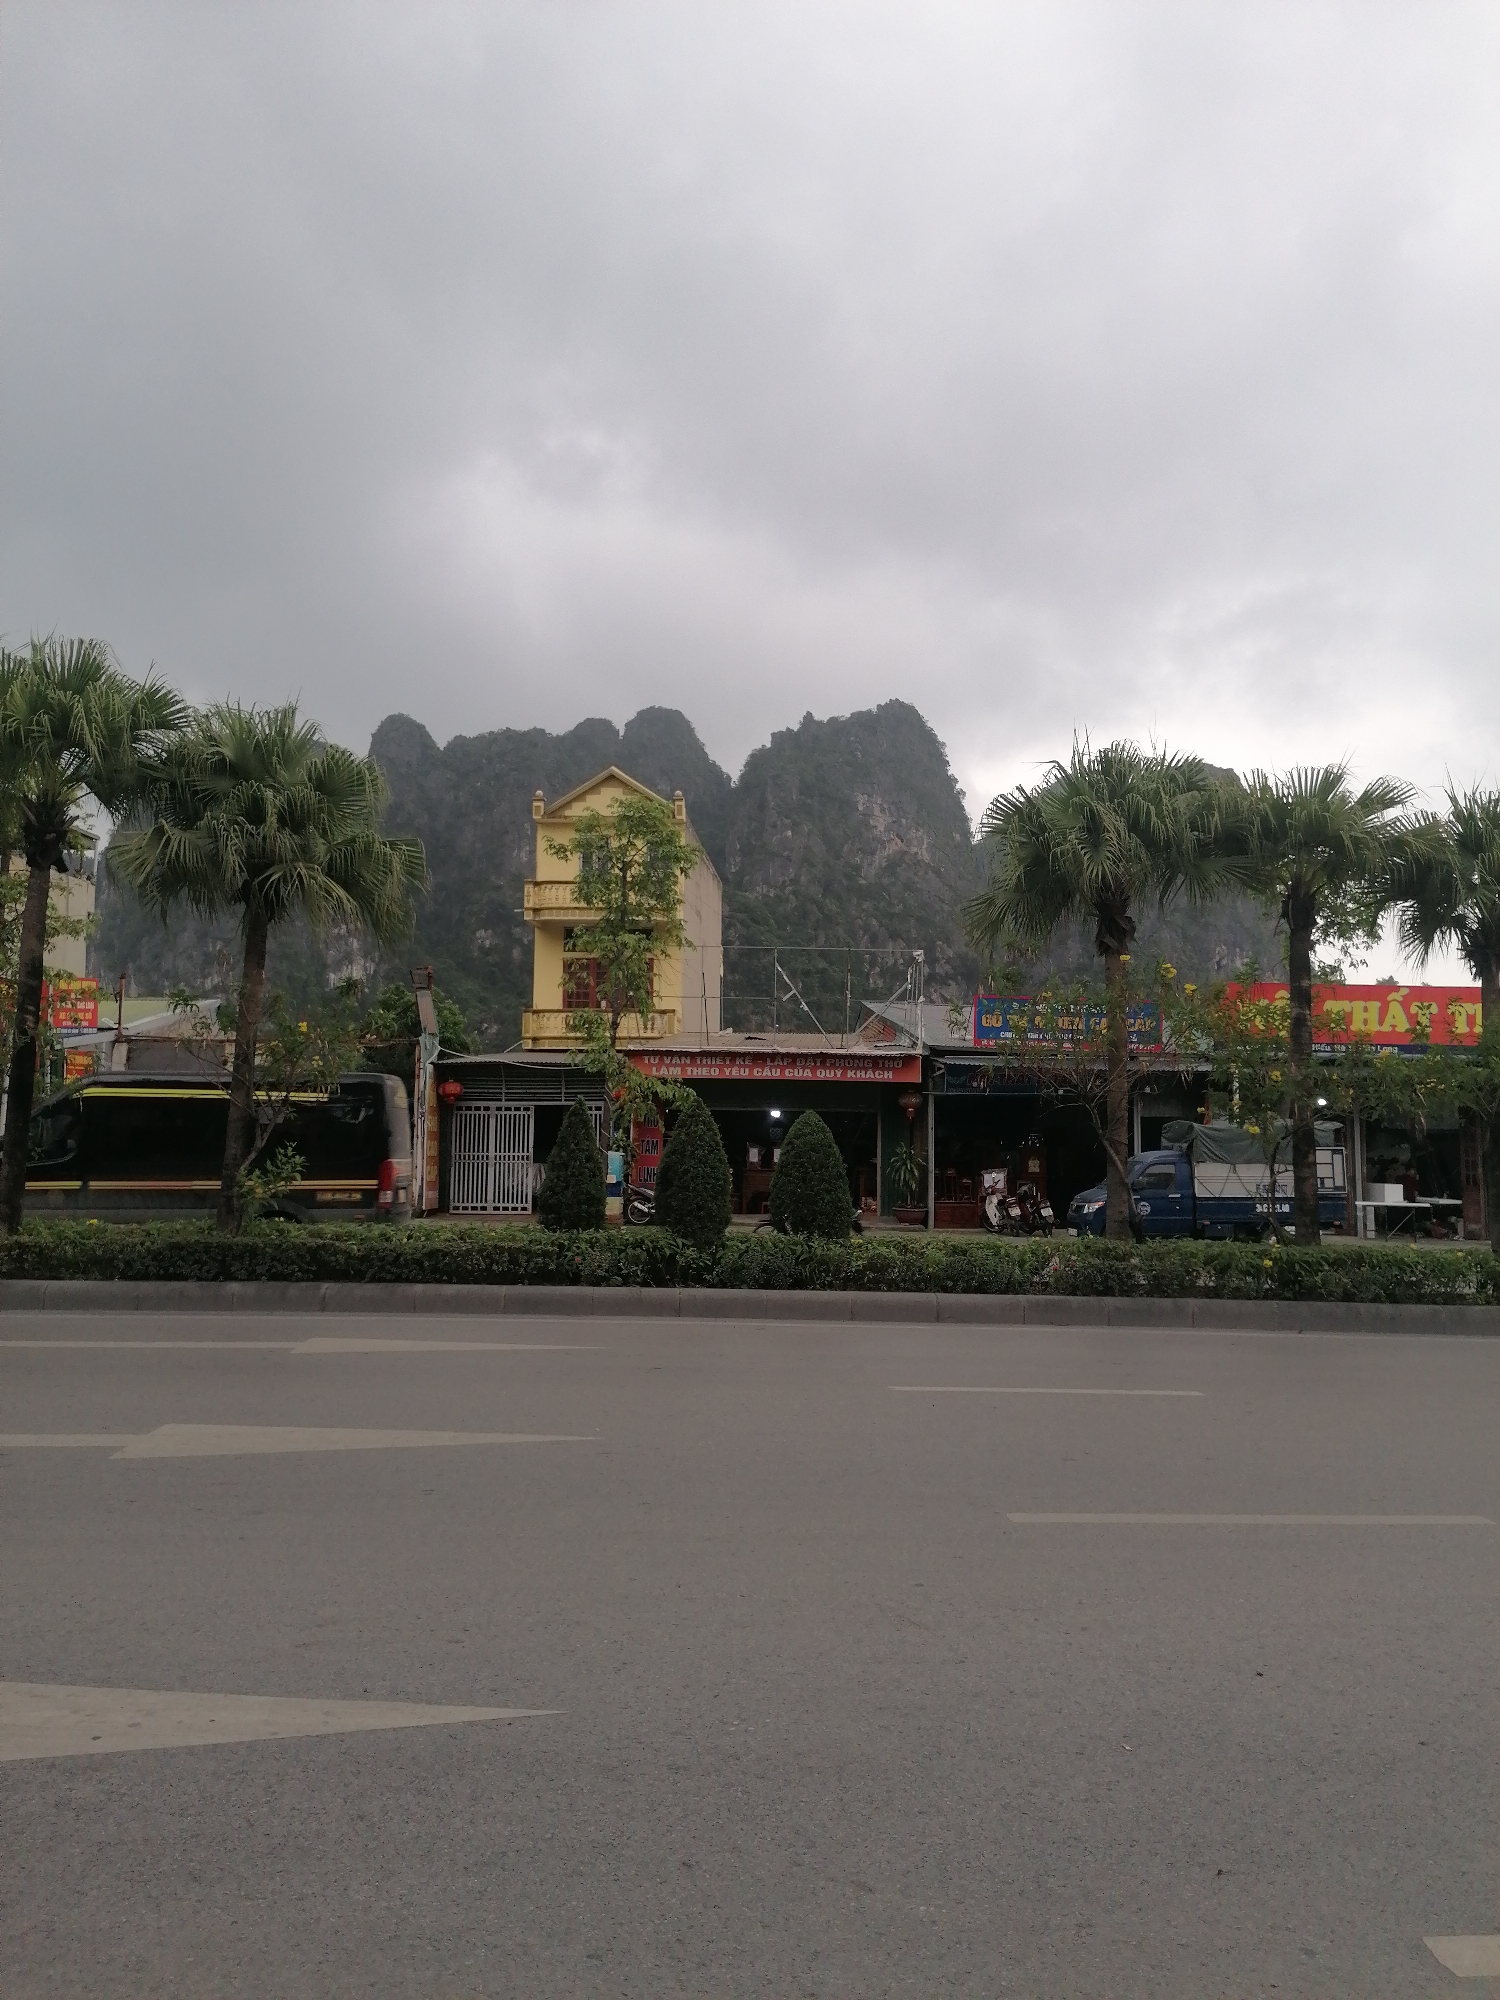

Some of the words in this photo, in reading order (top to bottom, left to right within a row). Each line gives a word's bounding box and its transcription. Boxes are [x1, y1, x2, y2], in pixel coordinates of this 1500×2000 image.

[1323, 987, 1438, 1034] THẤT
[643, 1055, 661, 1064] TƯ
[695, 1053, 732, 1066] THIẾT
[826, 1056, 874, 1069] PHÒNG
[652, 1065, 682, 1076] LÀM
[685, 1066, 722, 1077] THEO
[724, 1066, 750, 1077] YÊU
[847, 1067, 893, 1080] KHÁCH
